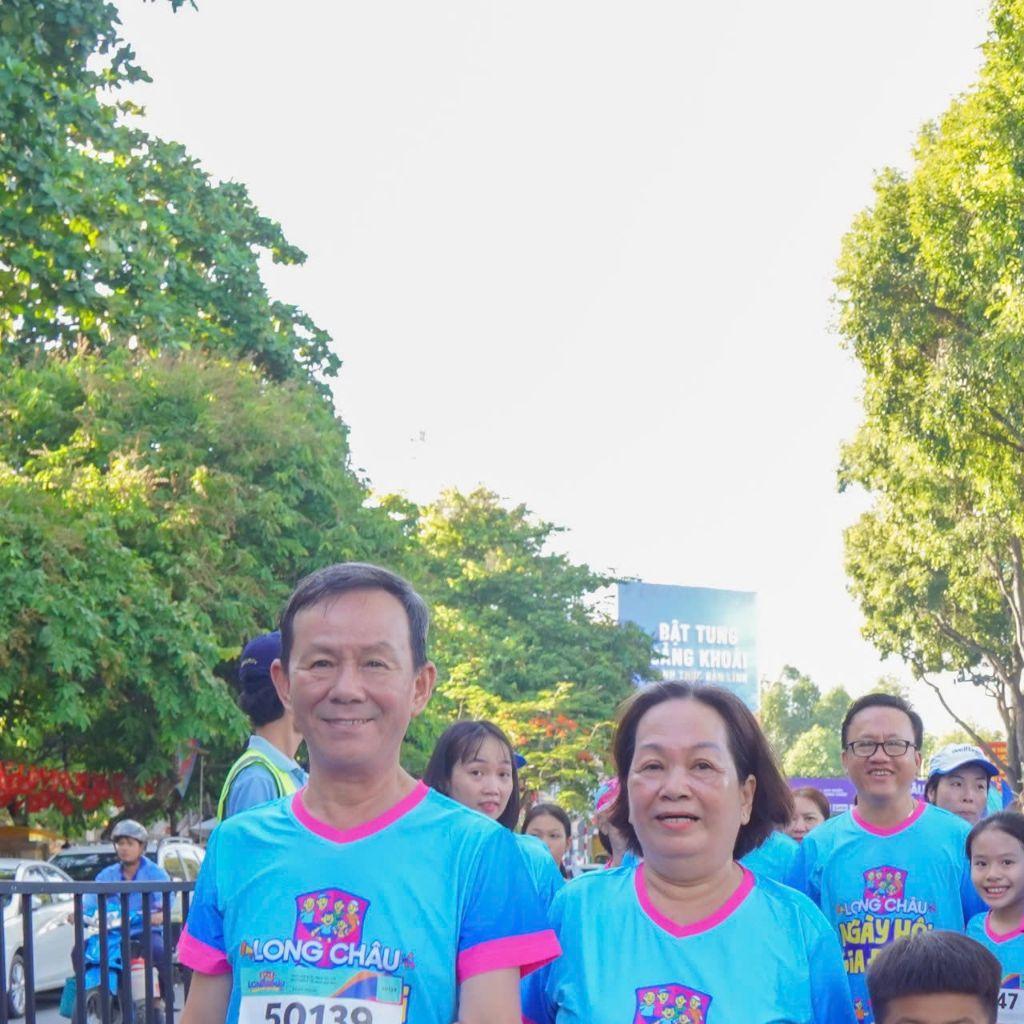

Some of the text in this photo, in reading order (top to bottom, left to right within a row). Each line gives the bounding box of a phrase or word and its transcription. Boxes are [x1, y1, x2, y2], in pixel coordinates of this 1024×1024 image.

[659, 619, 690, 645] BẬT
[845, 896, 927, 915] LONG CHÂU
[839, 915, 890, 946] NGÀY
[253, 939, 400, 971] LONG CHÂU
